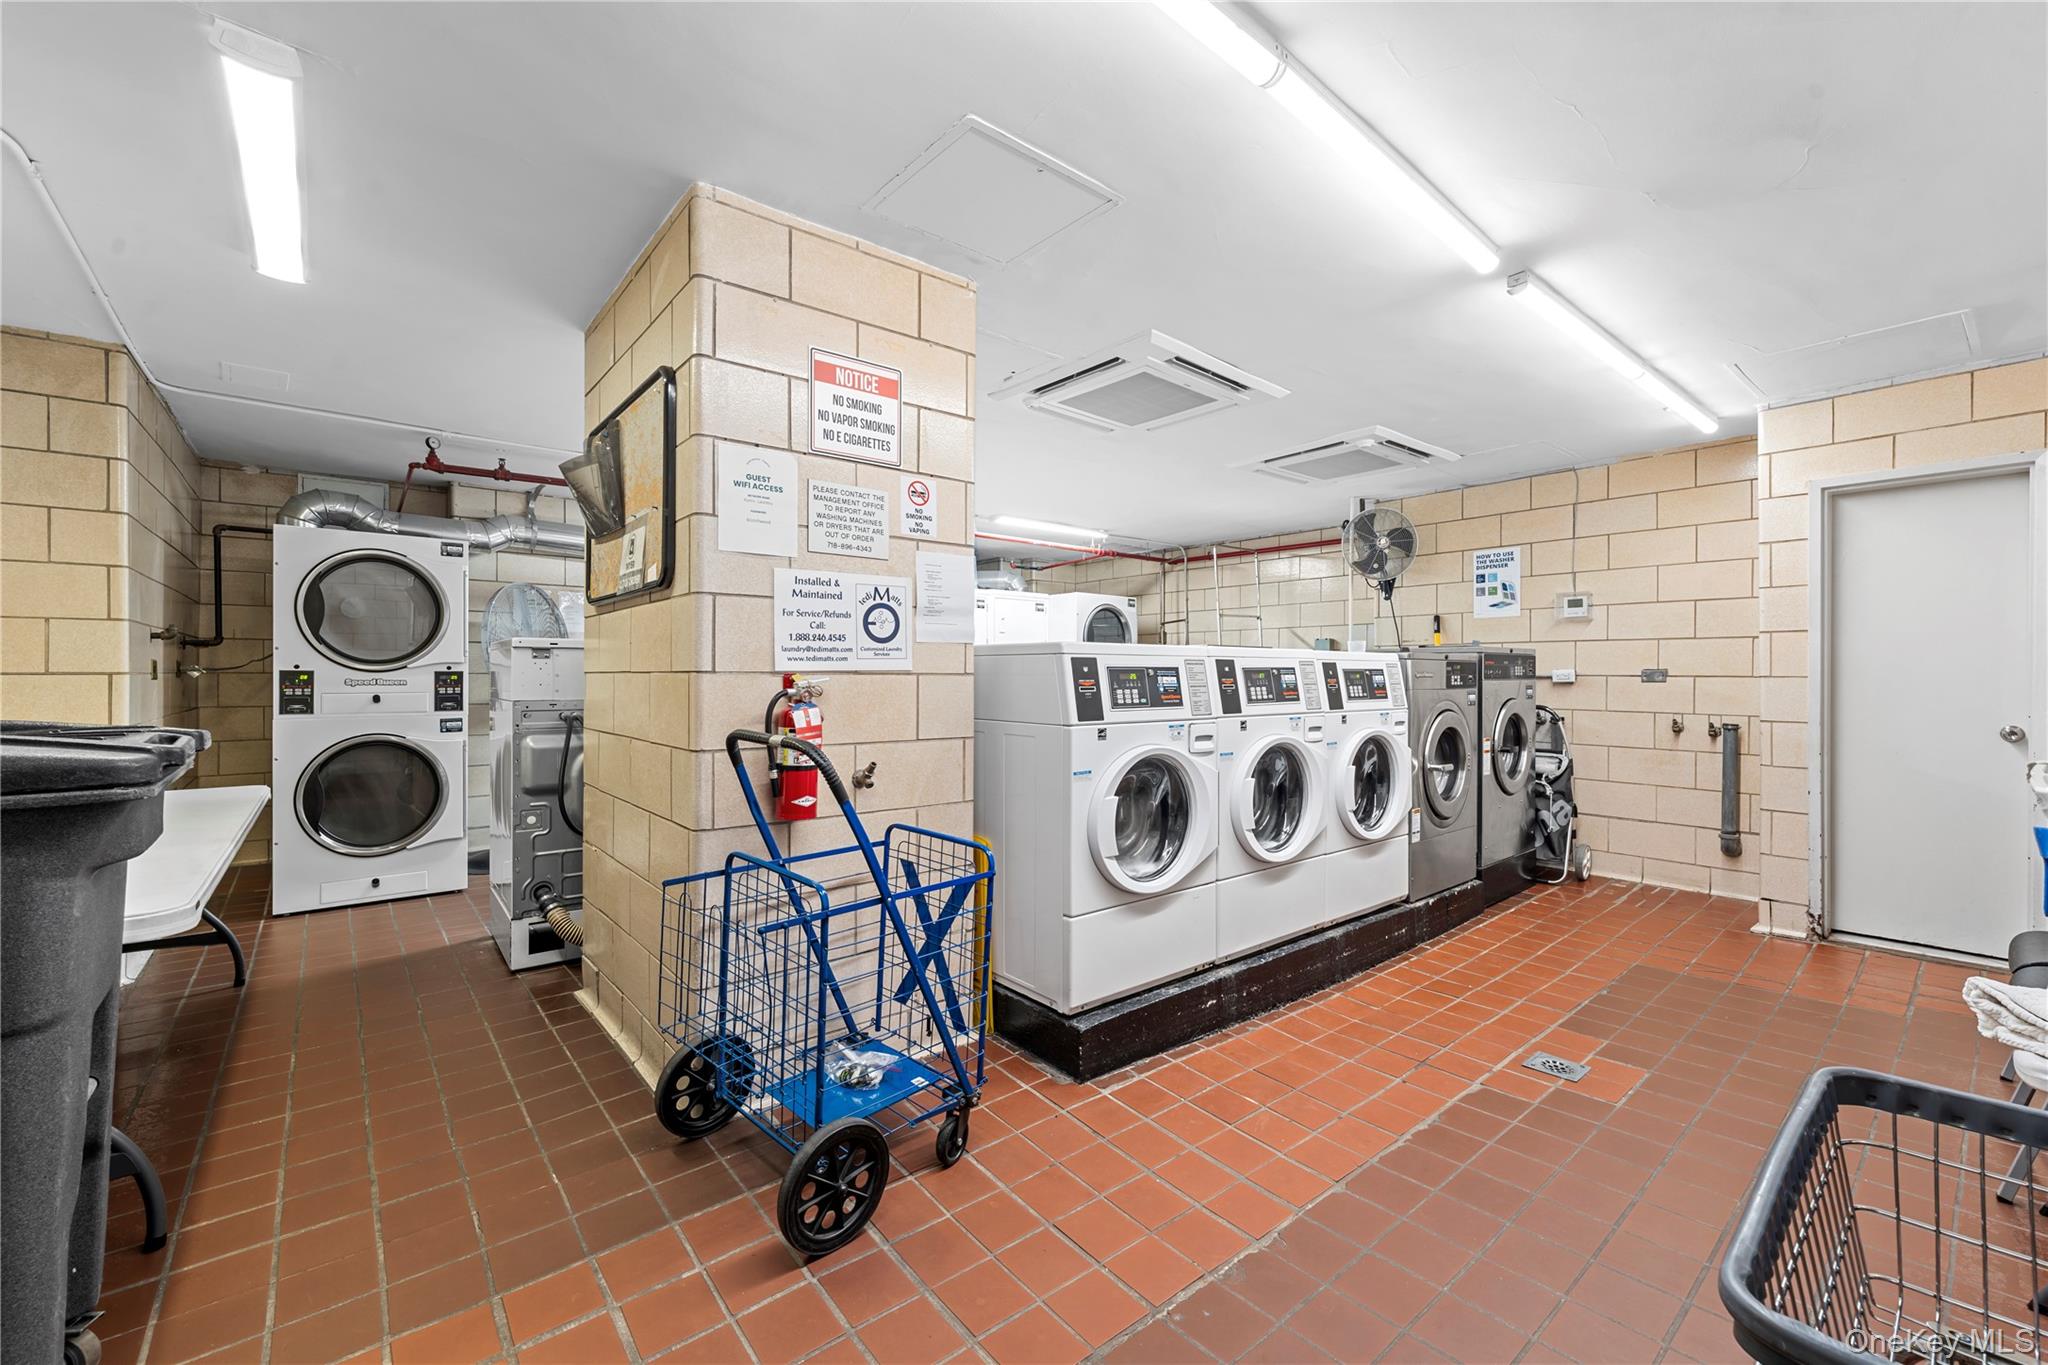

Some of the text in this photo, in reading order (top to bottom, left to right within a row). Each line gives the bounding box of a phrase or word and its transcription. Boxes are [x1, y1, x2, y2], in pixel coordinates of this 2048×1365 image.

[836, 367, 879, 393] NOTICE
[832, 394, 882, 415] NO SMOKING
[818, 409, 895, 435] NO VAPOR SMOKING
[823, 428, 891, 452] NO E CIGARETTES
[746, 474, 771, 483] GUEST
[733, 480, 784, 493] WIFI ACCESS
[813, 485, 885, 502] PLEASE CONTACT THE
[813, 494, 884, 510] MANAGEMENT OFFICE
[835, 506, 862, 515] REPORT
[816, 512, 882, 527] WASHING MACHINES
[906, 513, 932, 521] SMOKING
[826, 522, 852, 532] DRYERS
[852, 534, 874, 542] ORDER
[827, 542, 872, 553] 718-896-4343
[794, 576, 840, 587] Installed &
[792, 589, 842, 600] Maintained
[782, 608, 851, 618] For Service/Refunds
[809, 621, 826, 629] Call:
[789, 633, 847, 642] 1.888.246.4545
[344, 678, 407, 687] Speed Queen
